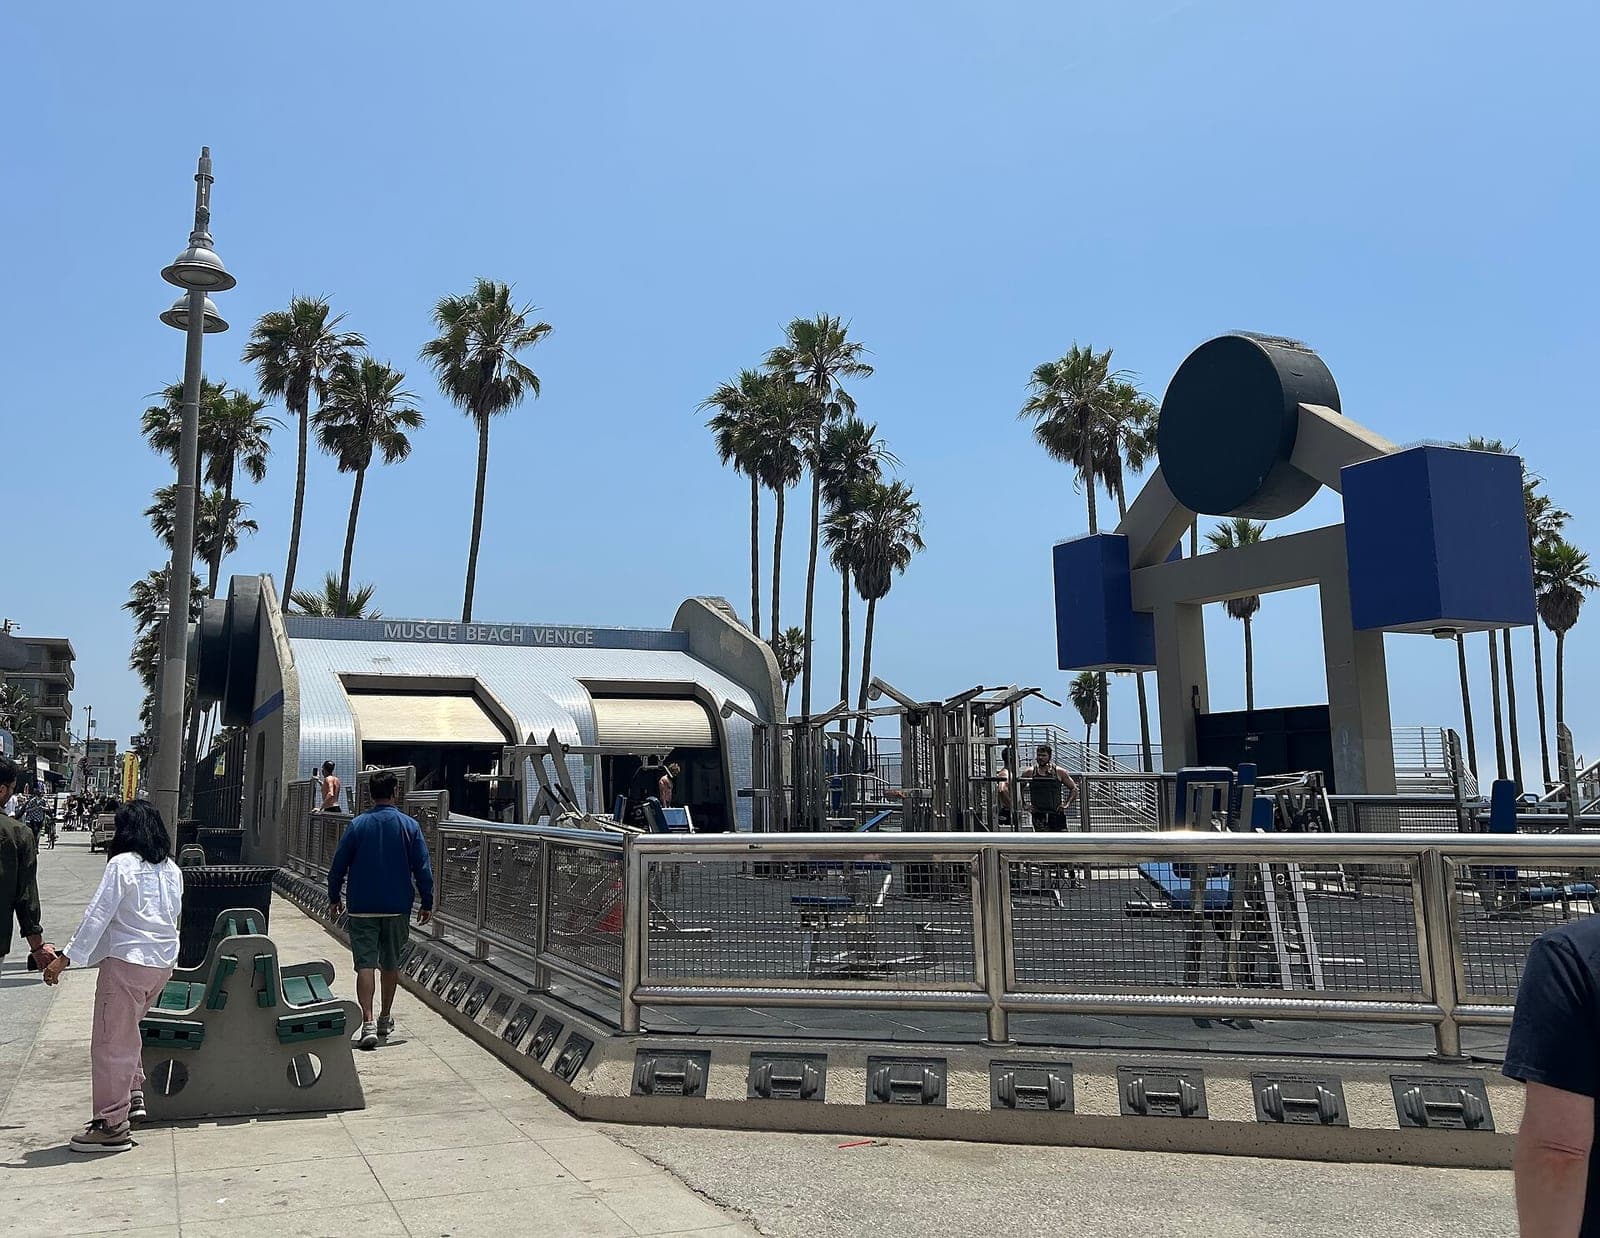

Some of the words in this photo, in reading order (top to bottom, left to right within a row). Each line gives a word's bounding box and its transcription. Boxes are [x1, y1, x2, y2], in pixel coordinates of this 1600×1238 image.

[384, 623, 457, 641] MUSCLE
[466, 626, 524, 643] BEACH
[532, 628, 594, 645] VENICE
